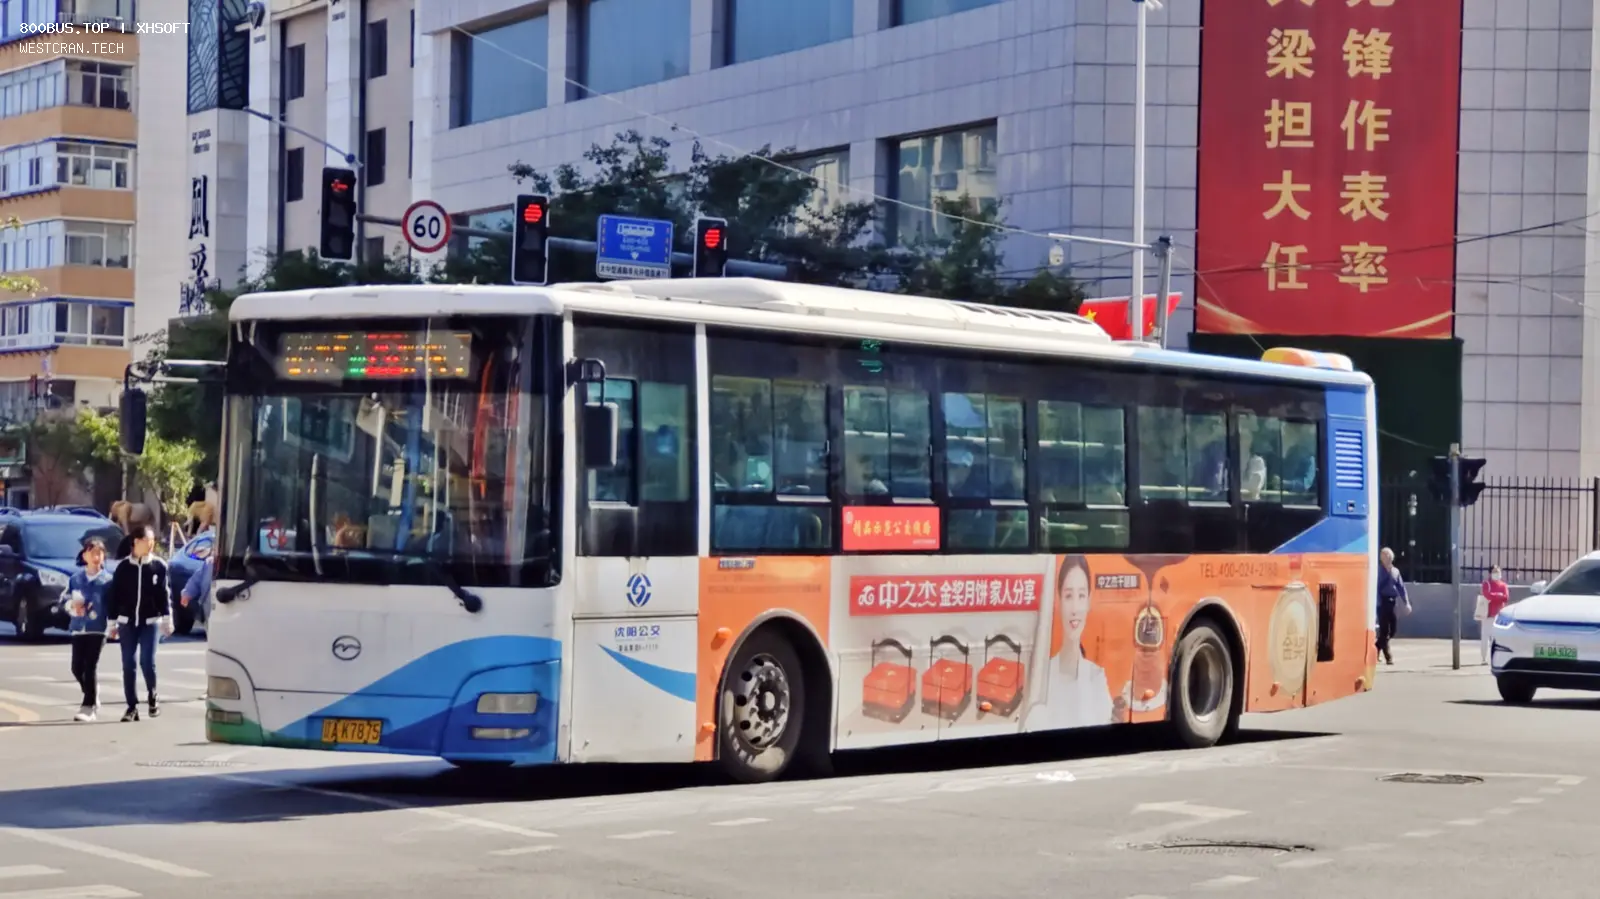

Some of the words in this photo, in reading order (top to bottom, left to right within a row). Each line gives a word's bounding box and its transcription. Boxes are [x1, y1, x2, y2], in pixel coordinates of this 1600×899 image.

[1262, 0, 1316, 291] 梁担大任
[1338, 0, 1395, 293] 锋作表率
[413, 215, 441, 239] 60
[614, 624, 661, 638] 沈阳公交
